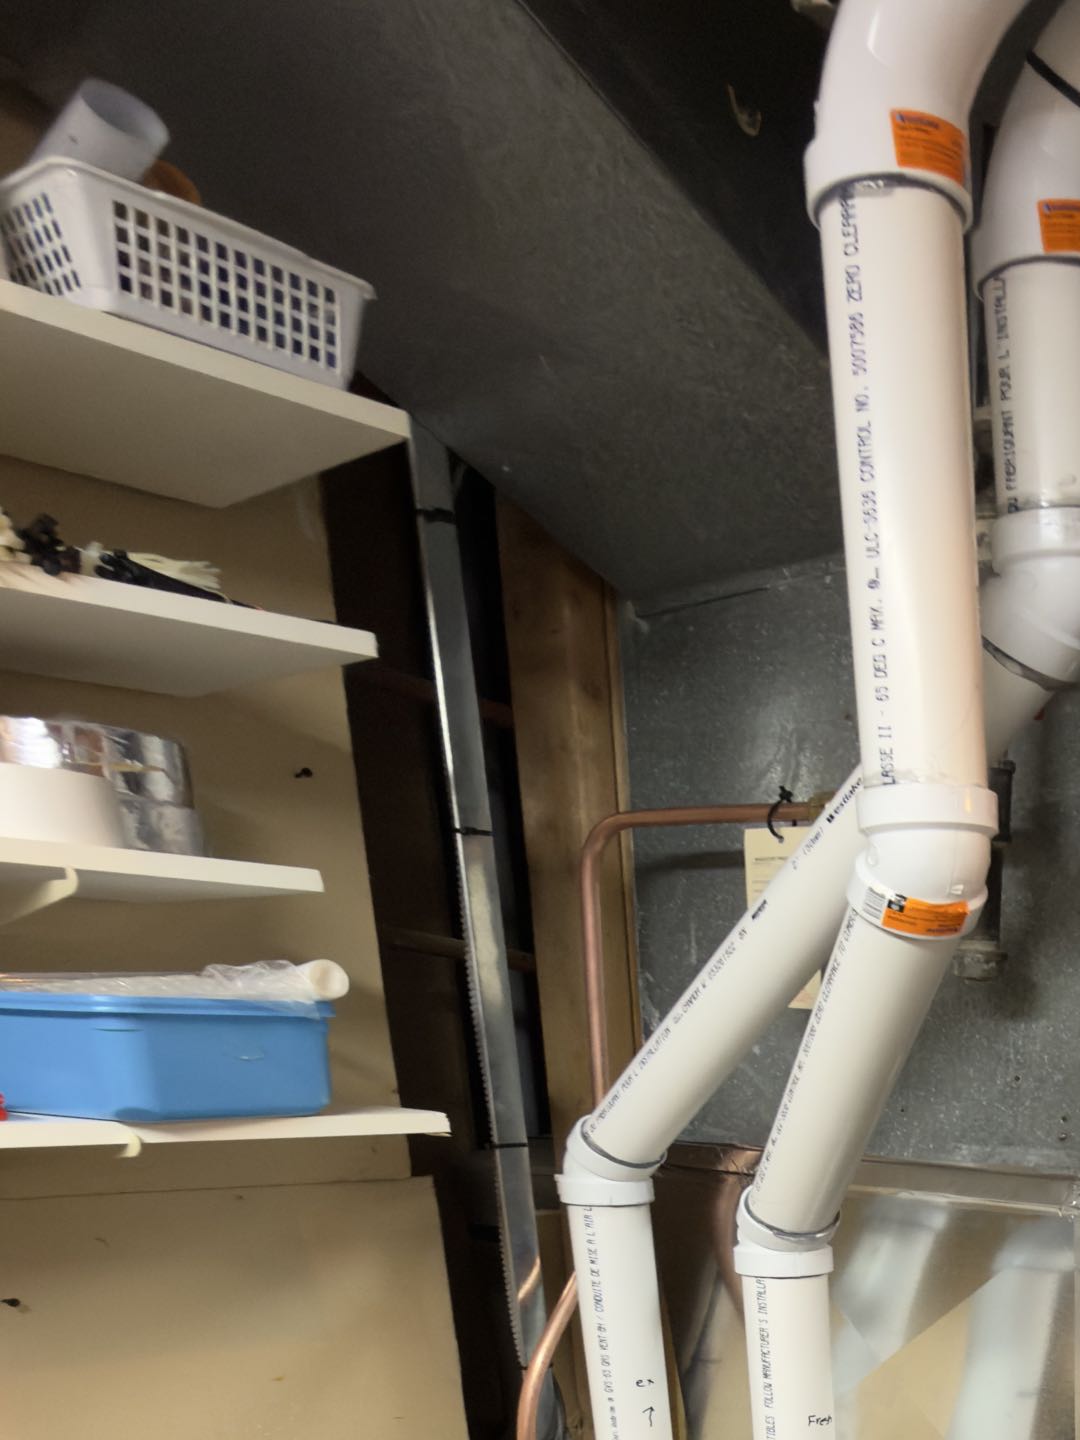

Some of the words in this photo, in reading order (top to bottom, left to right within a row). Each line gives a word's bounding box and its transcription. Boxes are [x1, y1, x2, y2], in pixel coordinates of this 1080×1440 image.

[845, 263, 863, 302] ZERO
[856, 420, 875, 483] CONTROL
[761, 1382, 774, 1409] FOLLOW
